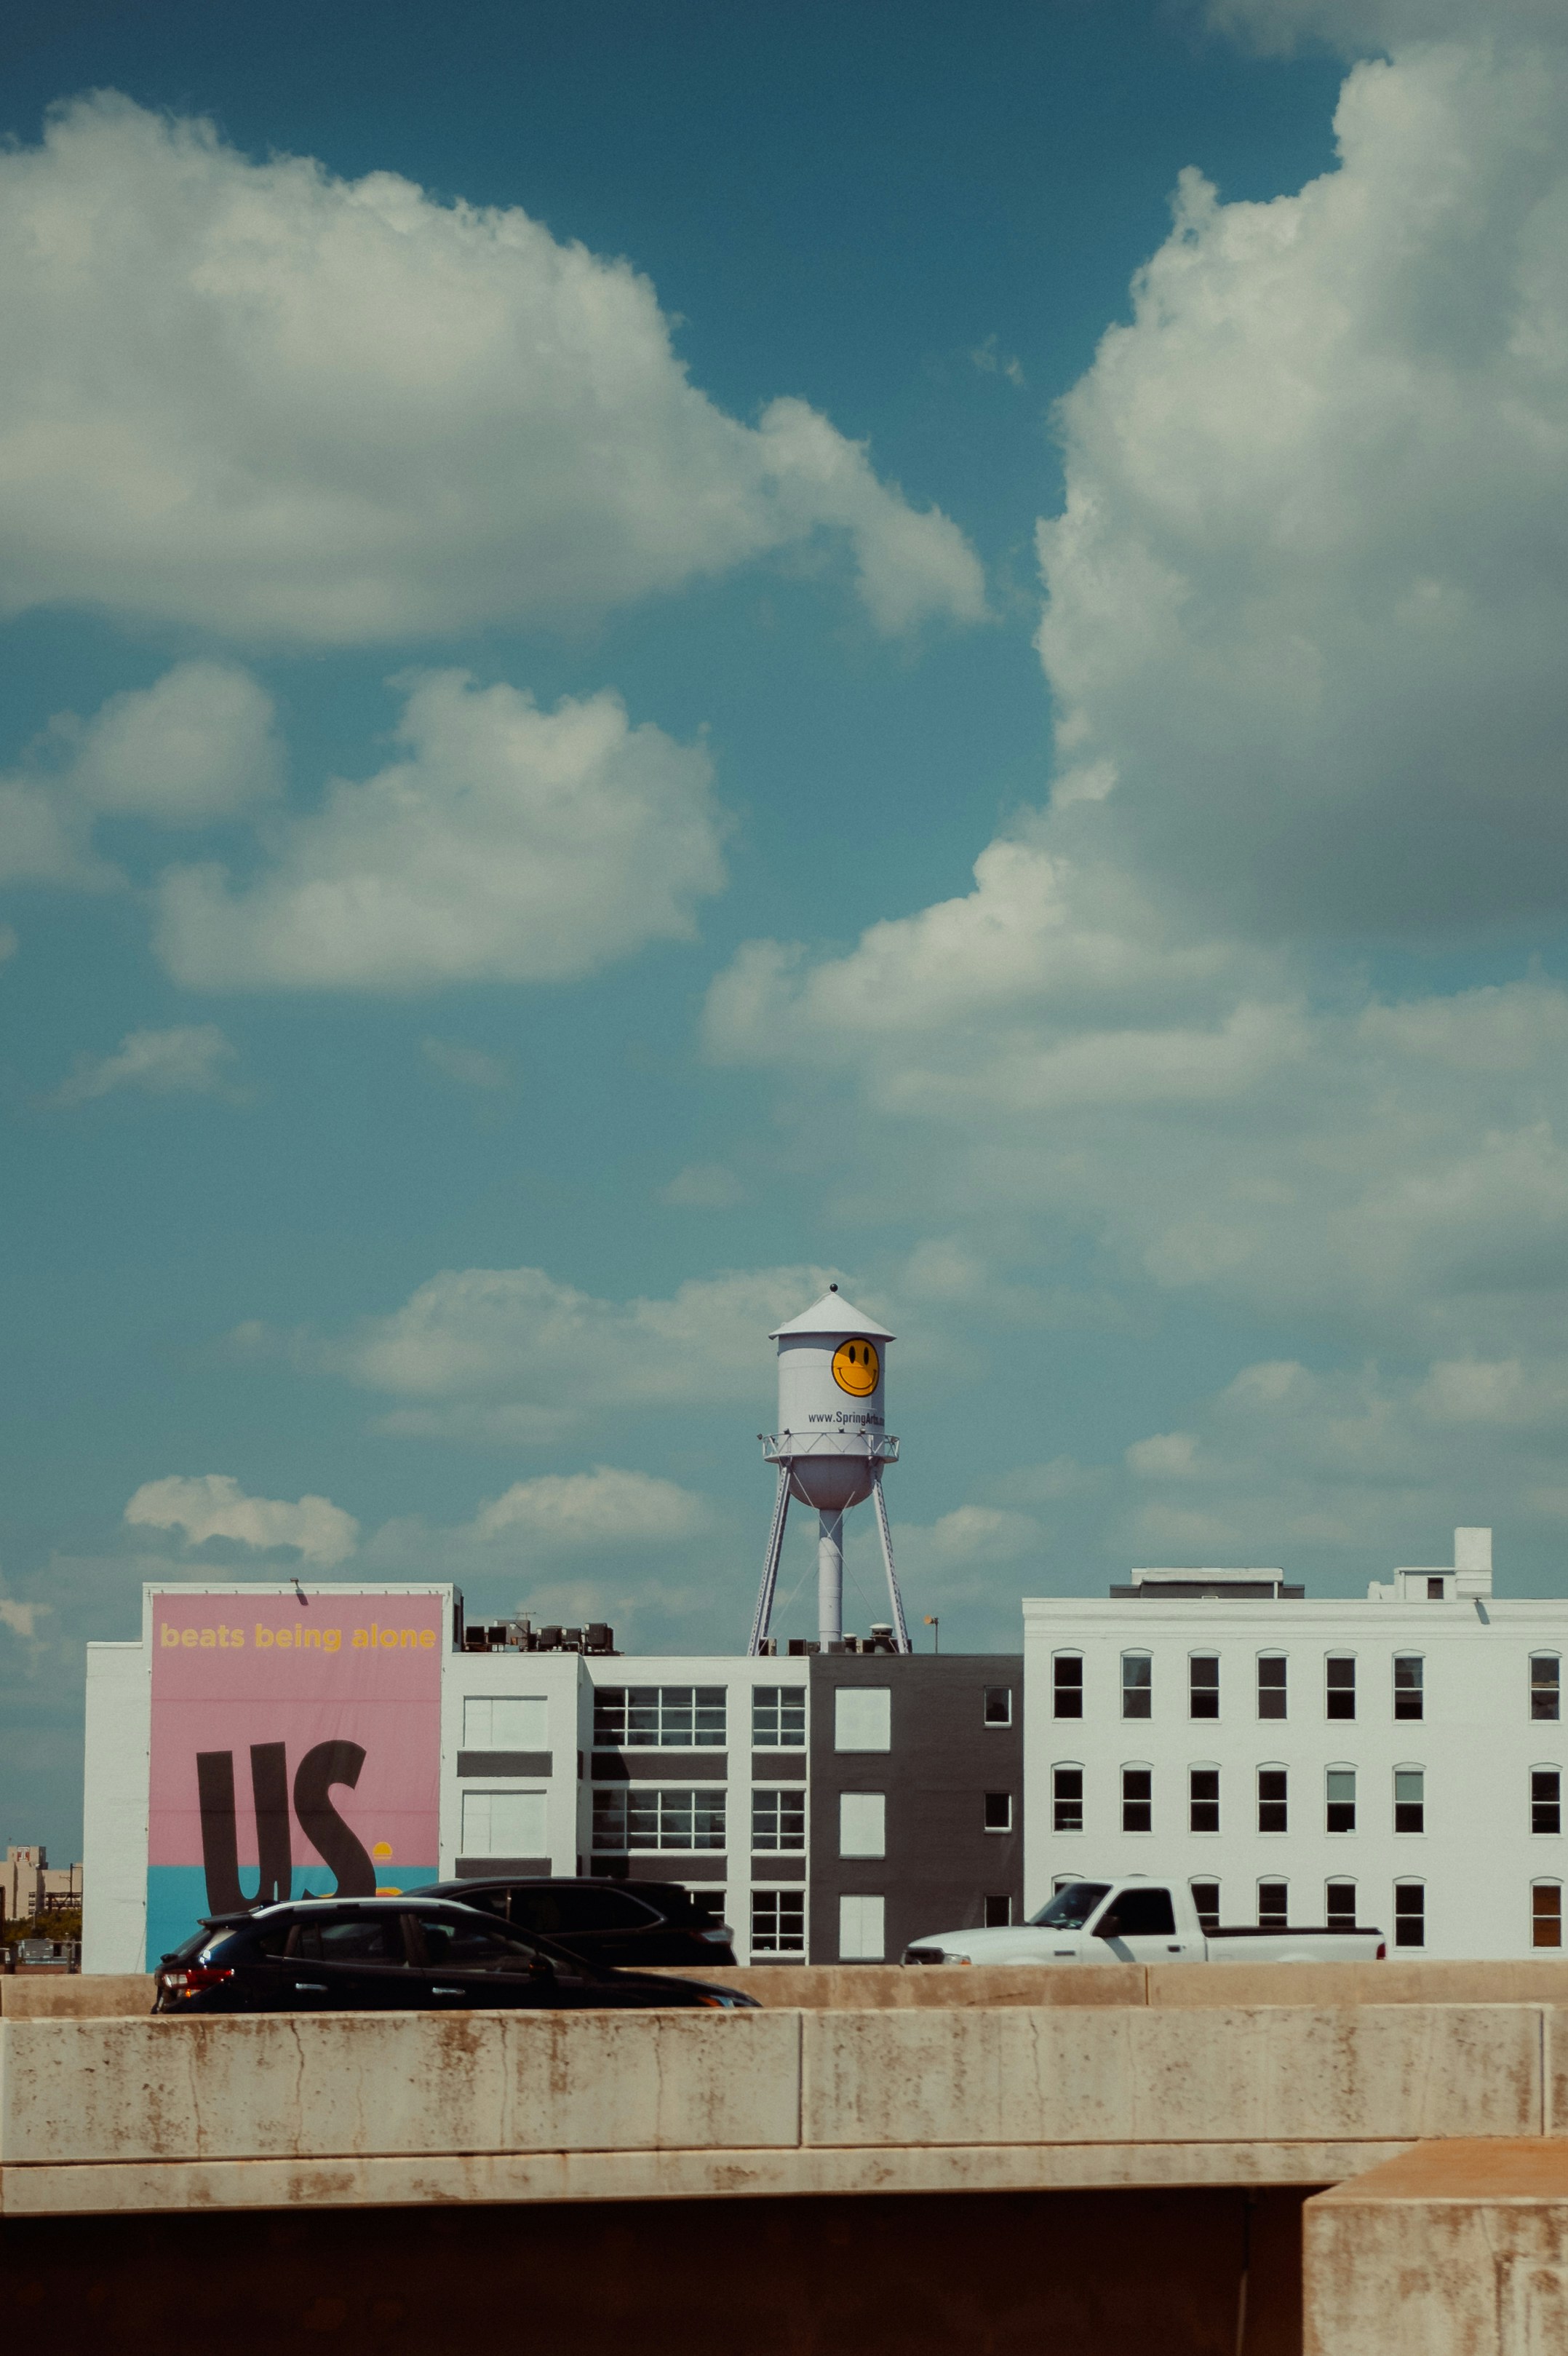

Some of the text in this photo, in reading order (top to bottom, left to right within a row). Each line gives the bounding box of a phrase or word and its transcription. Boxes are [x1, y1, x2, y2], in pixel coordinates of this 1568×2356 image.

[161, 1623, 437, 1652] beats being alone
[17, 1846, 31, 1862] T
